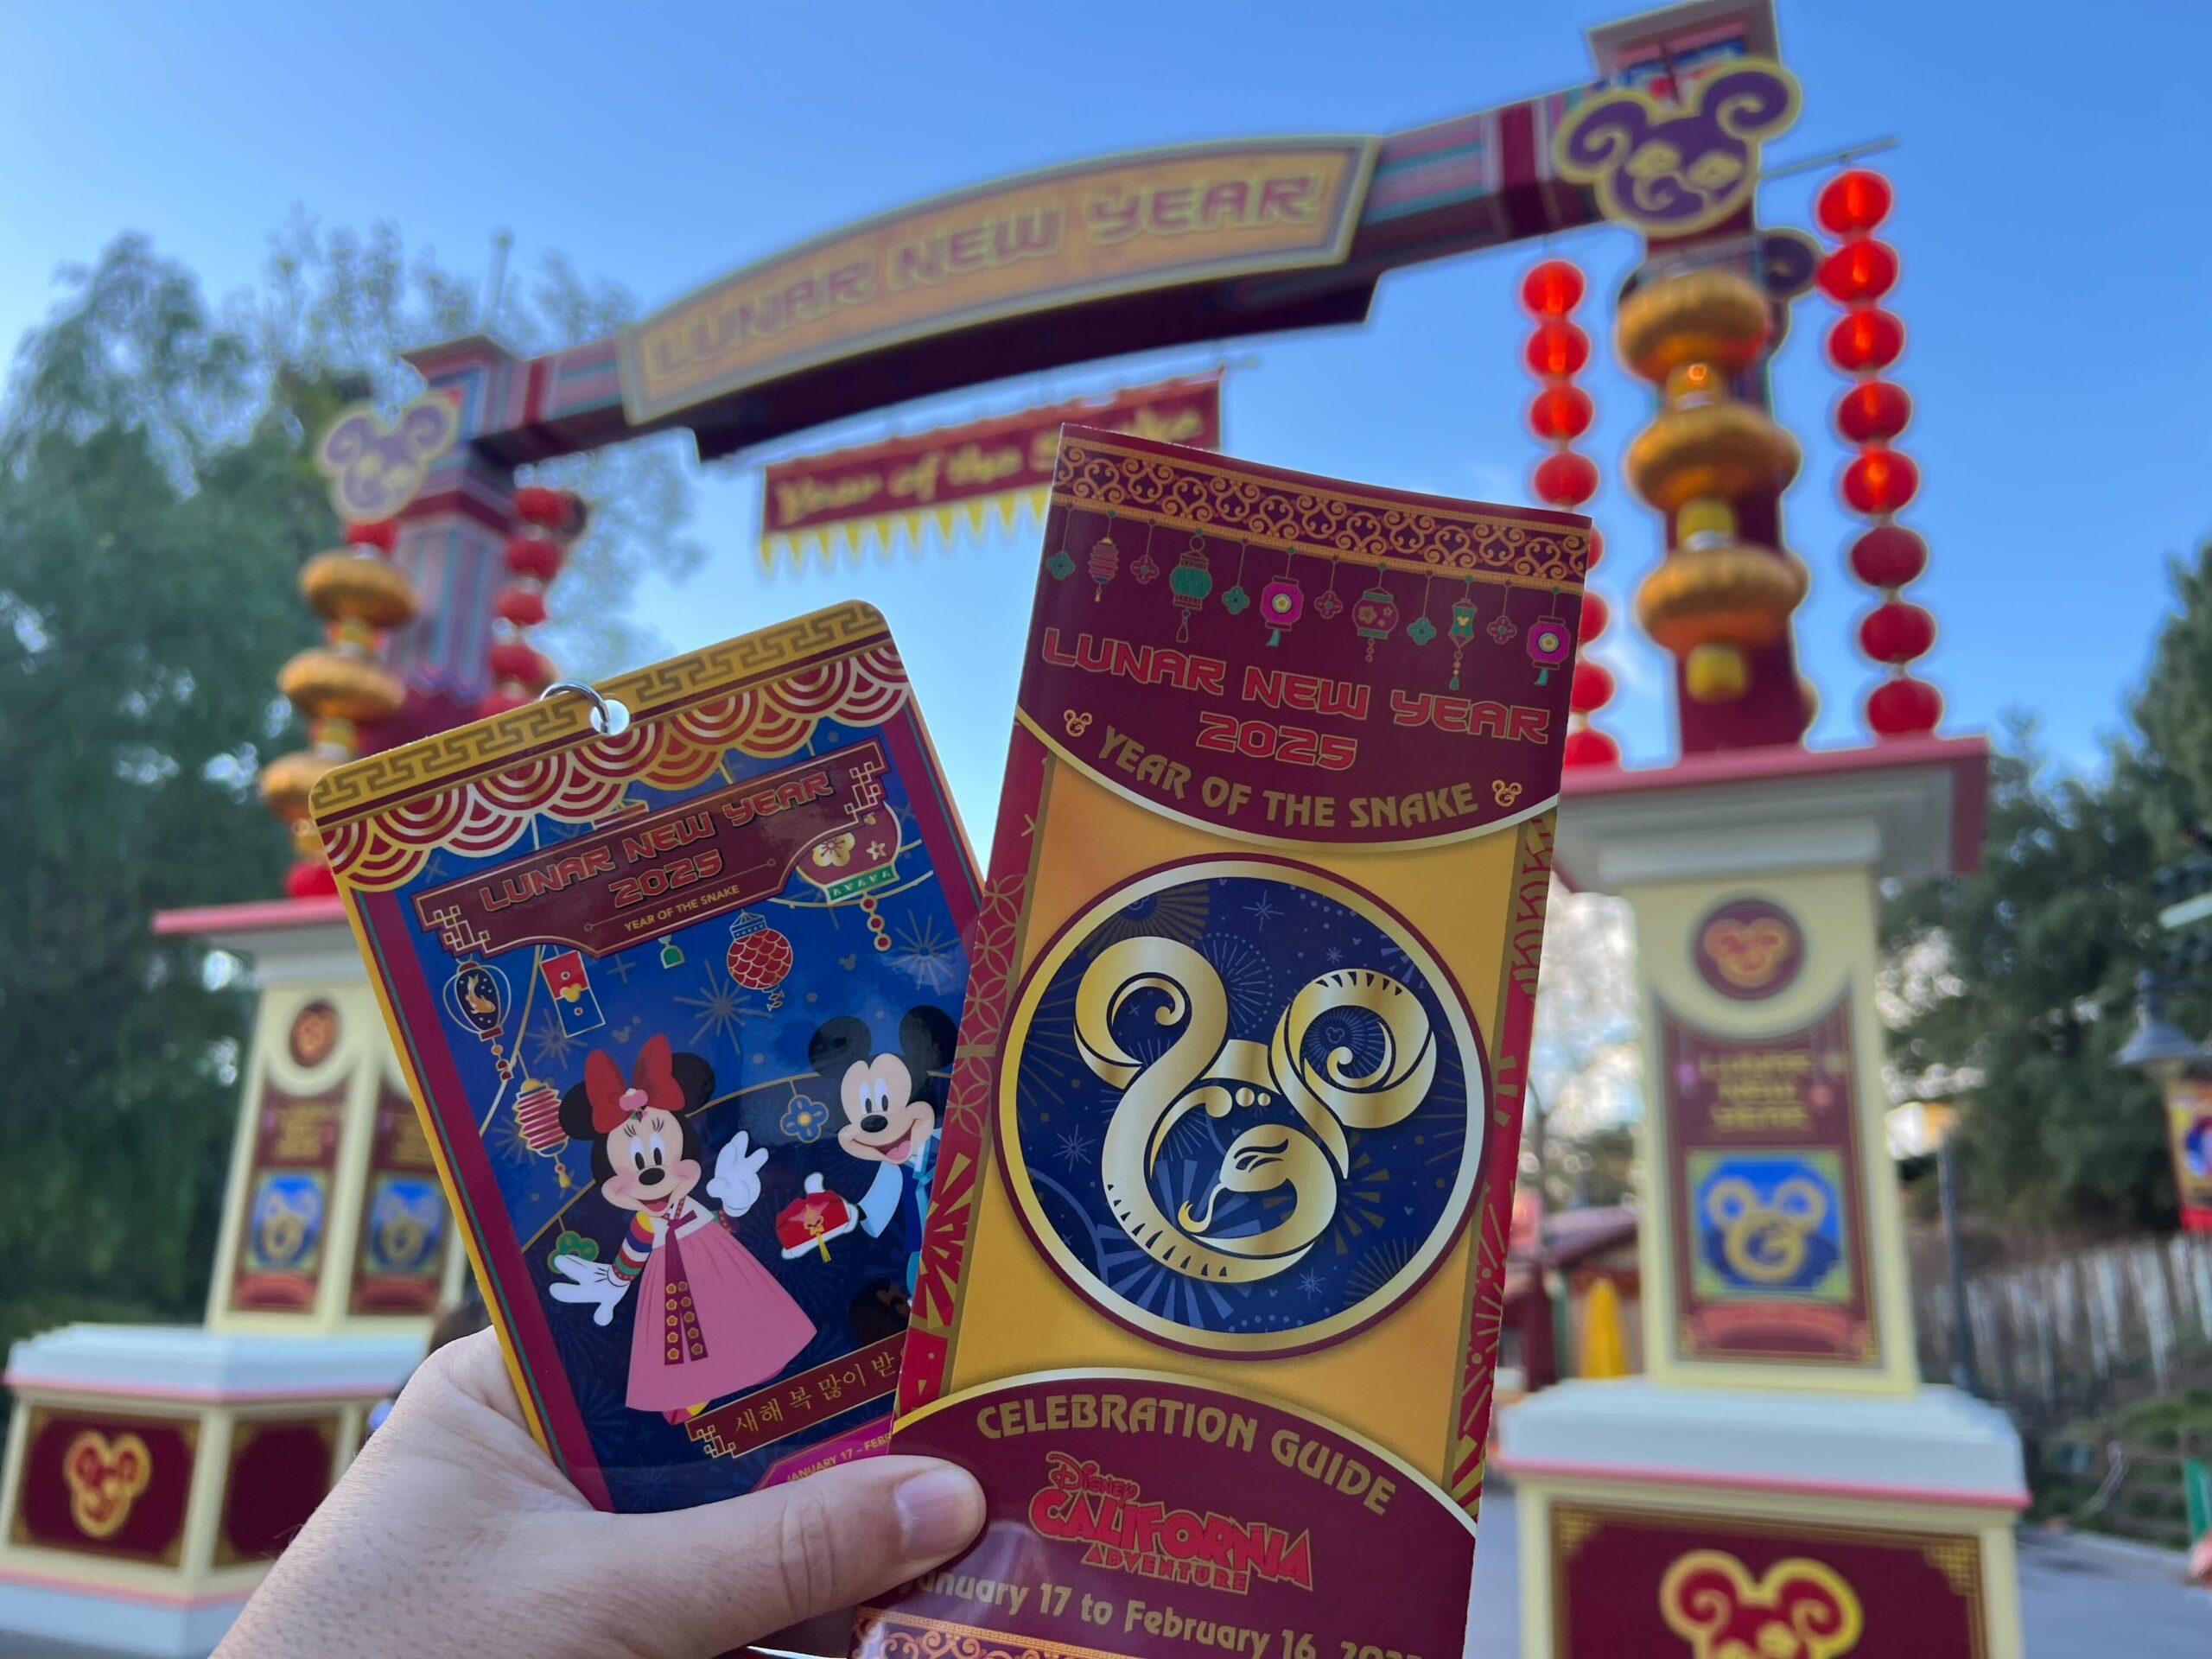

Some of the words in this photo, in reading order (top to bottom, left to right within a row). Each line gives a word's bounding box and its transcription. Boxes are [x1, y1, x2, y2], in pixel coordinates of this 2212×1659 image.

[650, 256, 875, 385] LUNAR
[890, 200, 1068, 292] NEW
[1084, 168, 1322, 247] YEAR
[775, 474, 883, 524] Year
[887, 450, 943, 502] of
[949, 443, 1025, 486] the
[1043, 627, 1226, 696] LUNAR
[1242, 665, 1371, 720] NEW
[1389, 689, 1550, 745] YEAR
[1097, 725, 1192, 800] YEAR
[1201, 776, 1252, 816] OF
[1262, 789, 1336, 827] THE
[1349, 782, 1478, 829] SNAKE
[1195, 711, 1358, 772] 2025
[479, 847, 616, 912] LUNAR
[621, 811, 717, 863] NEW
[722, 772, 836, 827] YEAR
[609, 849, 724, 908] 2025
[624, 911, 655, 932] YEAR
[657, 906, 675, 920] OF
[676, 898, 699, 914] THE
[700, 884, 741, 907] SNAKE
[736, 1398, 784, 1433] 새해
[789, 1386, 813, 1411] 복
[817, 1363, 867, 1402] 많이
[840, 1447, 854, 1461] 17
[864, 1433, 892, 1452] FEBR
[976, 1394, 1258, 1453] CELEBRATION
[1271, 1428, 1396, 1516] GUIDE
[1028, 1485, 1313, 1592] CALIFORNIA
[1080, 1543, 1251, 1595] ADVENTURE
[1039, 1583, 1074, 1618] 17
[1081, 1592, 1113, 1625] to
[1124, 1599, 1272, 1659] February
